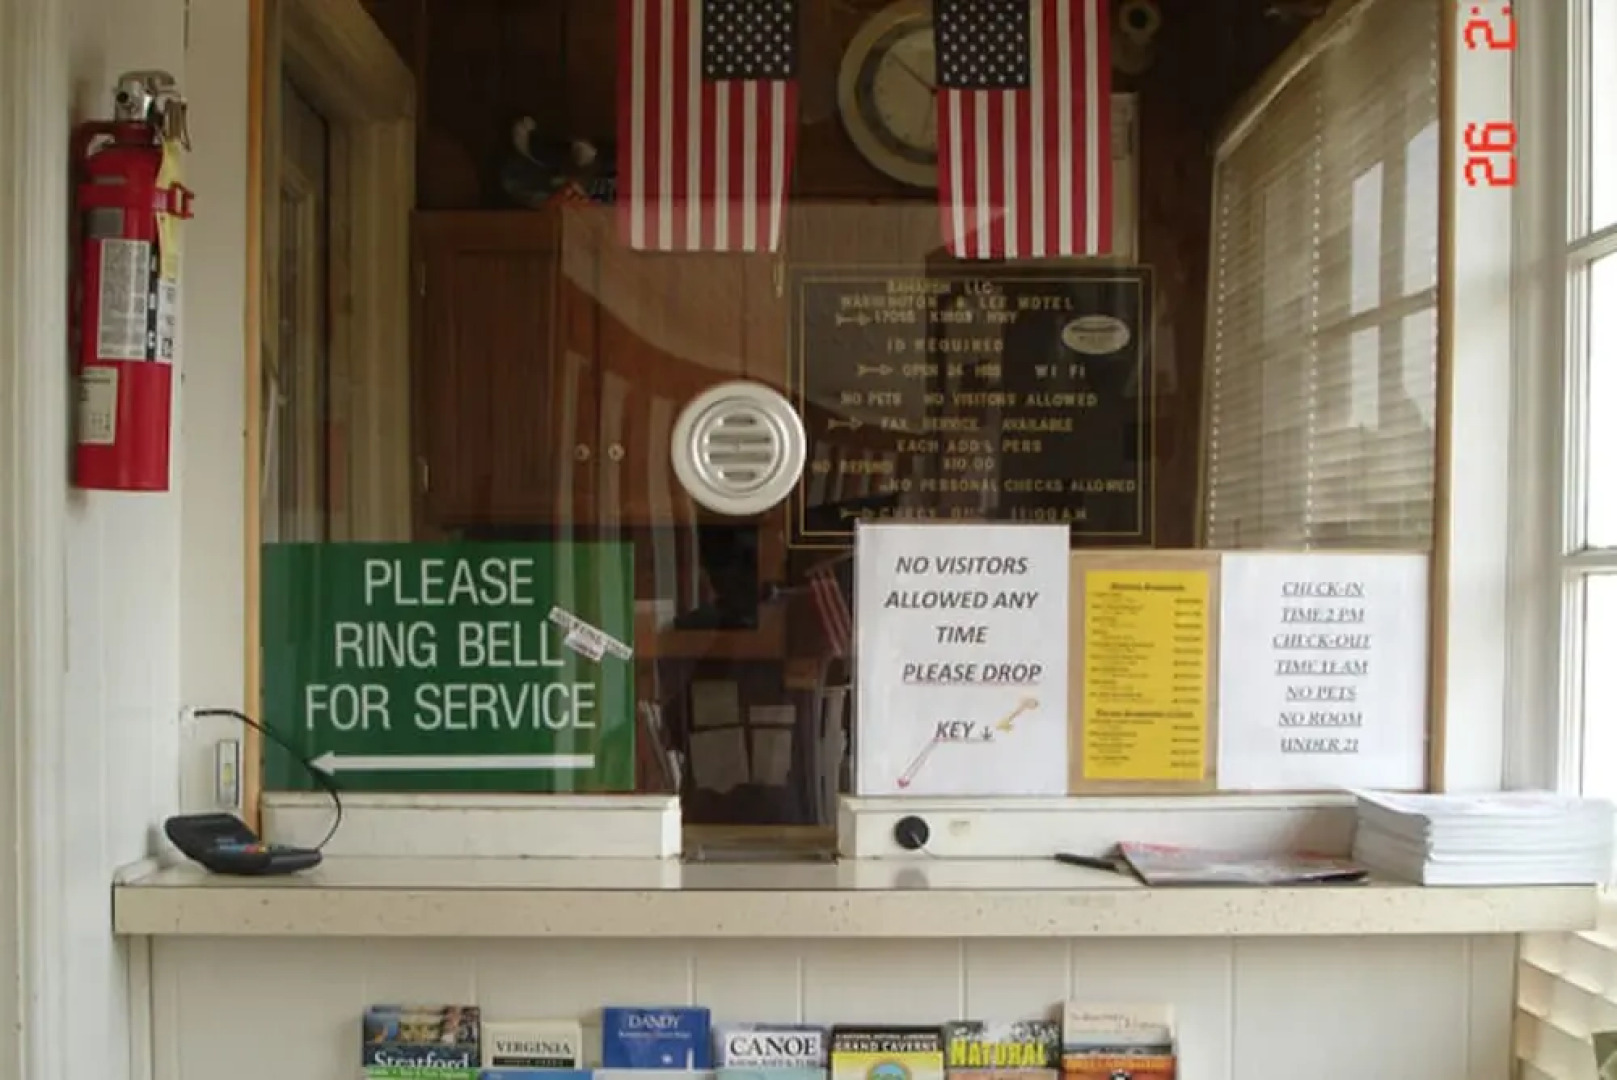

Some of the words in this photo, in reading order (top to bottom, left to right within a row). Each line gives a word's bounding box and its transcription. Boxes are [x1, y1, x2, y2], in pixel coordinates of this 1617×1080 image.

[1018, 296, 1075, 311] MOTEL
[887, 338, 906, 352] ID
[915, 338, 1004, 352] REQUIRED
[841, 391, 866, 407] NO
[924, 392, 945, 407] NO
[1026, 392, 1099, 408] ALLOWED
[1002, 417, 1075, 433] AVAILABLE
[897, 439, 940, 453] EACH
[919, 478, 998, 493] PERSONAL
[1004, 478, 1064, 493] CHECKS
[1070, 478, 1136, 493] ALLOWED
[895, 556, 929, 575] NO
[934, 556, 1029, 575] VISITORS
[365, 558, 535, 606] PLEASE
[1281, 581, 1365, 597] CHECK-IN
[884, 591, 989, 609] ALLOWED
[991, 591, 1039, 609] ANY
[1281, 607, 1321, 623] TIME
[1325, 607, 1335, 623] 2
[1337, 607, 1365, 623] PM
[935, 626, 990, 644] TIME
[1272, 633, 1372, 649] CHECK-OUT
[335, 620, 438, 668] RING
[458, 620, 565, 668] BELL
[903, 664, 977, 683] PLEASE
[982, 664, 1043, 683] DROP
[1275, 659, 1318, 675] TIME
[1321, 659, 1338, 675] 11
[1340, 659, 1369, 675] AM
[1286, 685, 1312, 701] NO
[1316, 685, 1357, 701] PETS
[305, 683, 392, 731] FOR
[414, 683, 596, 731] SERVICE
[1278, 711, 1306, 727] NO
[1308, 711, 1363, 727] ROOM
[934, 721, 976, 740] KEY
[1280, 737, 1340, 753] UNDER
[1342, 737, 1360, 753] 21
[628, 1014, 680, 1029] DANDY
[496, 1040, 572, 1055] VIRGINIA
[730, 1037, 816, 1057] CANOE
[835, 1040, 879, 1052] GRAND
[950, 1037, 1046, 1066] NATURAL
[374, 1050, 470, 1068] Stratford
